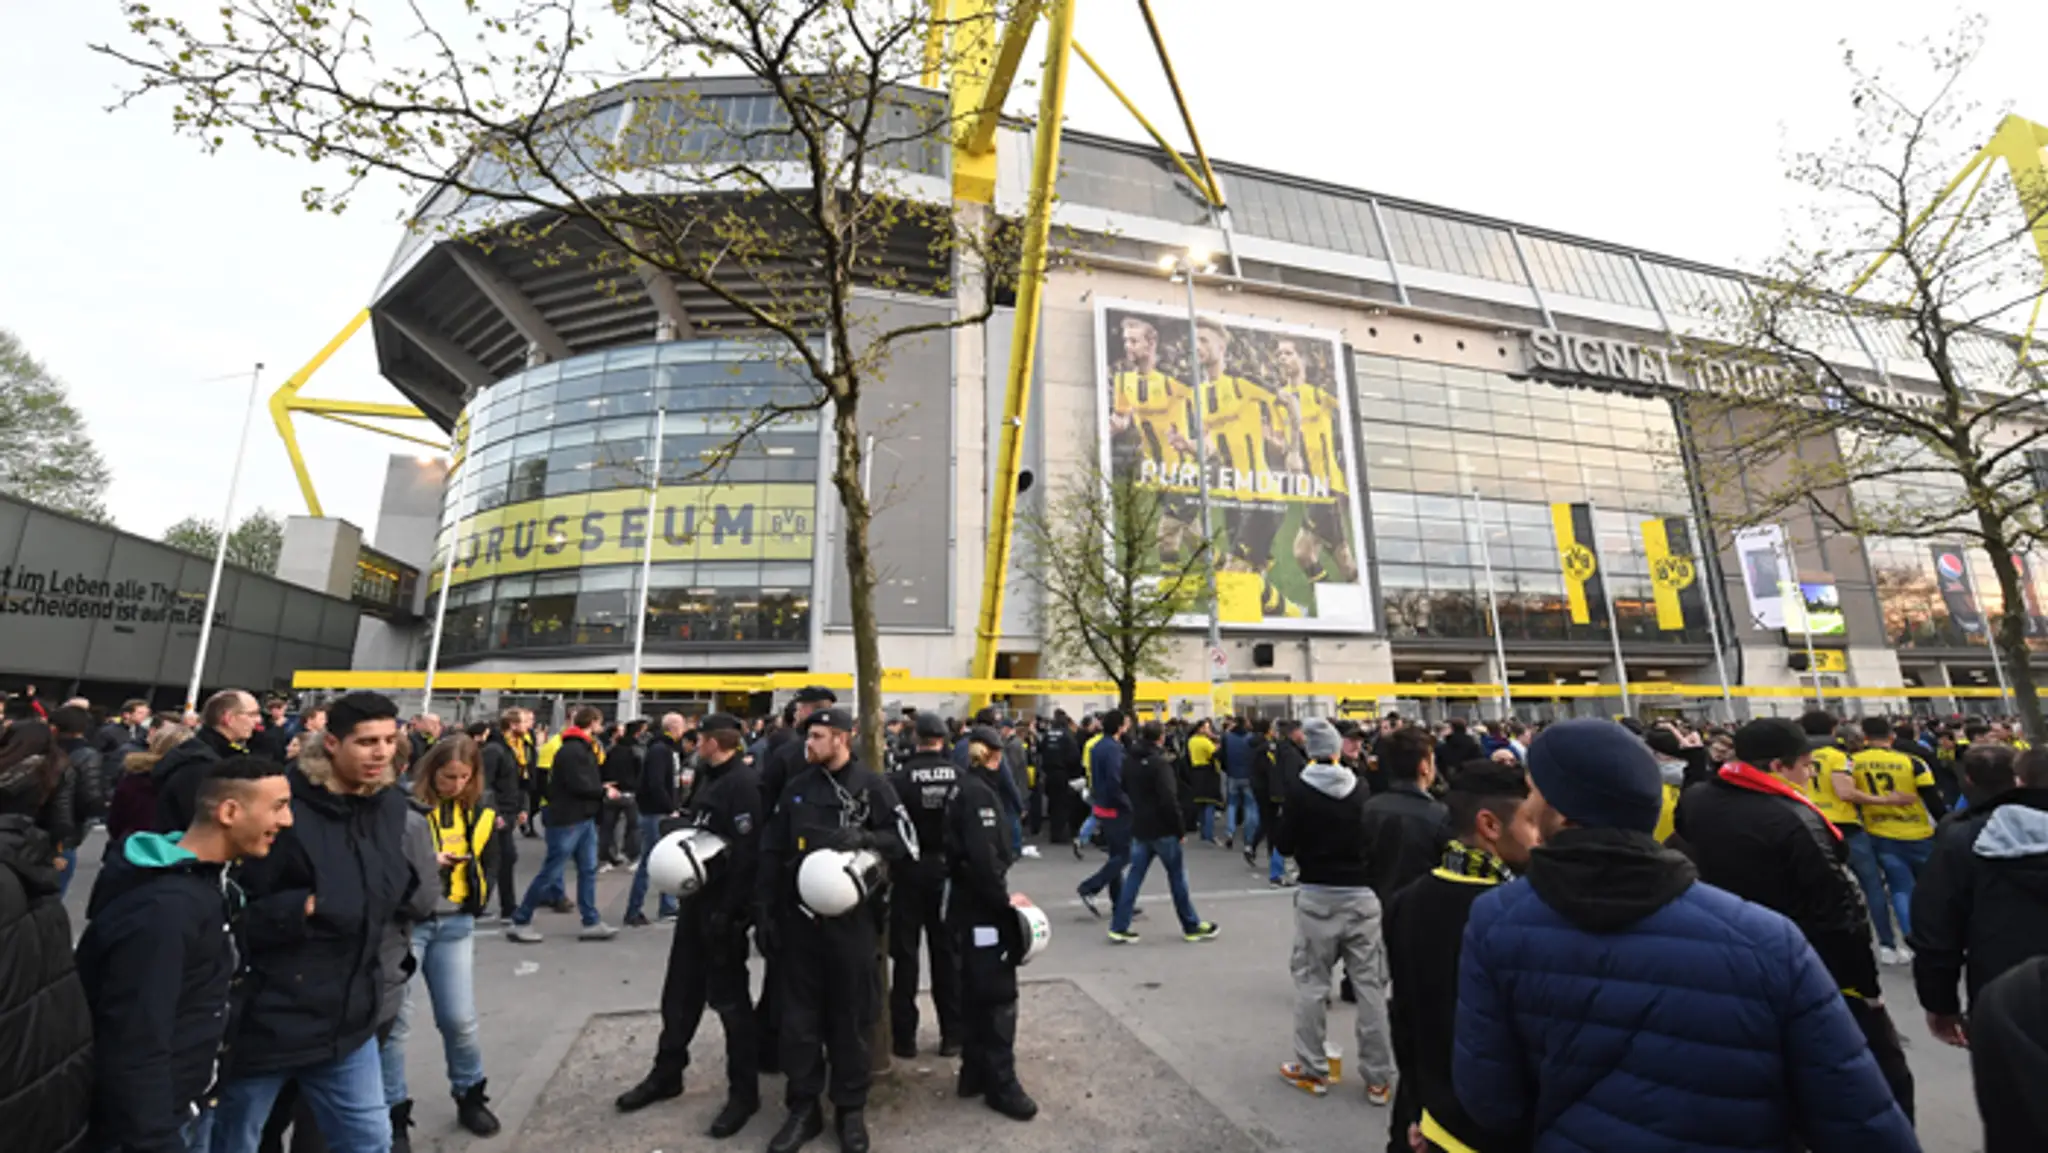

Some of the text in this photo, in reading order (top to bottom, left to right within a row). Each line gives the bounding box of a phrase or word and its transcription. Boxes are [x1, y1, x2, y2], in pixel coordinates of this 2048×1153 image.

[1531, 329, 1687, 386] SIGNAL
[1140, 459, 1330, 498] PURE EMOTION
[771, 508, 806, 534] BVB
[17, 564, 45, 594] im
[49, 569, 111, 598] Leben
[114, 579, 147, 601] alle
[115, 601, 137, 621] ist
[911, 766, 957, 783] POLIZEI
